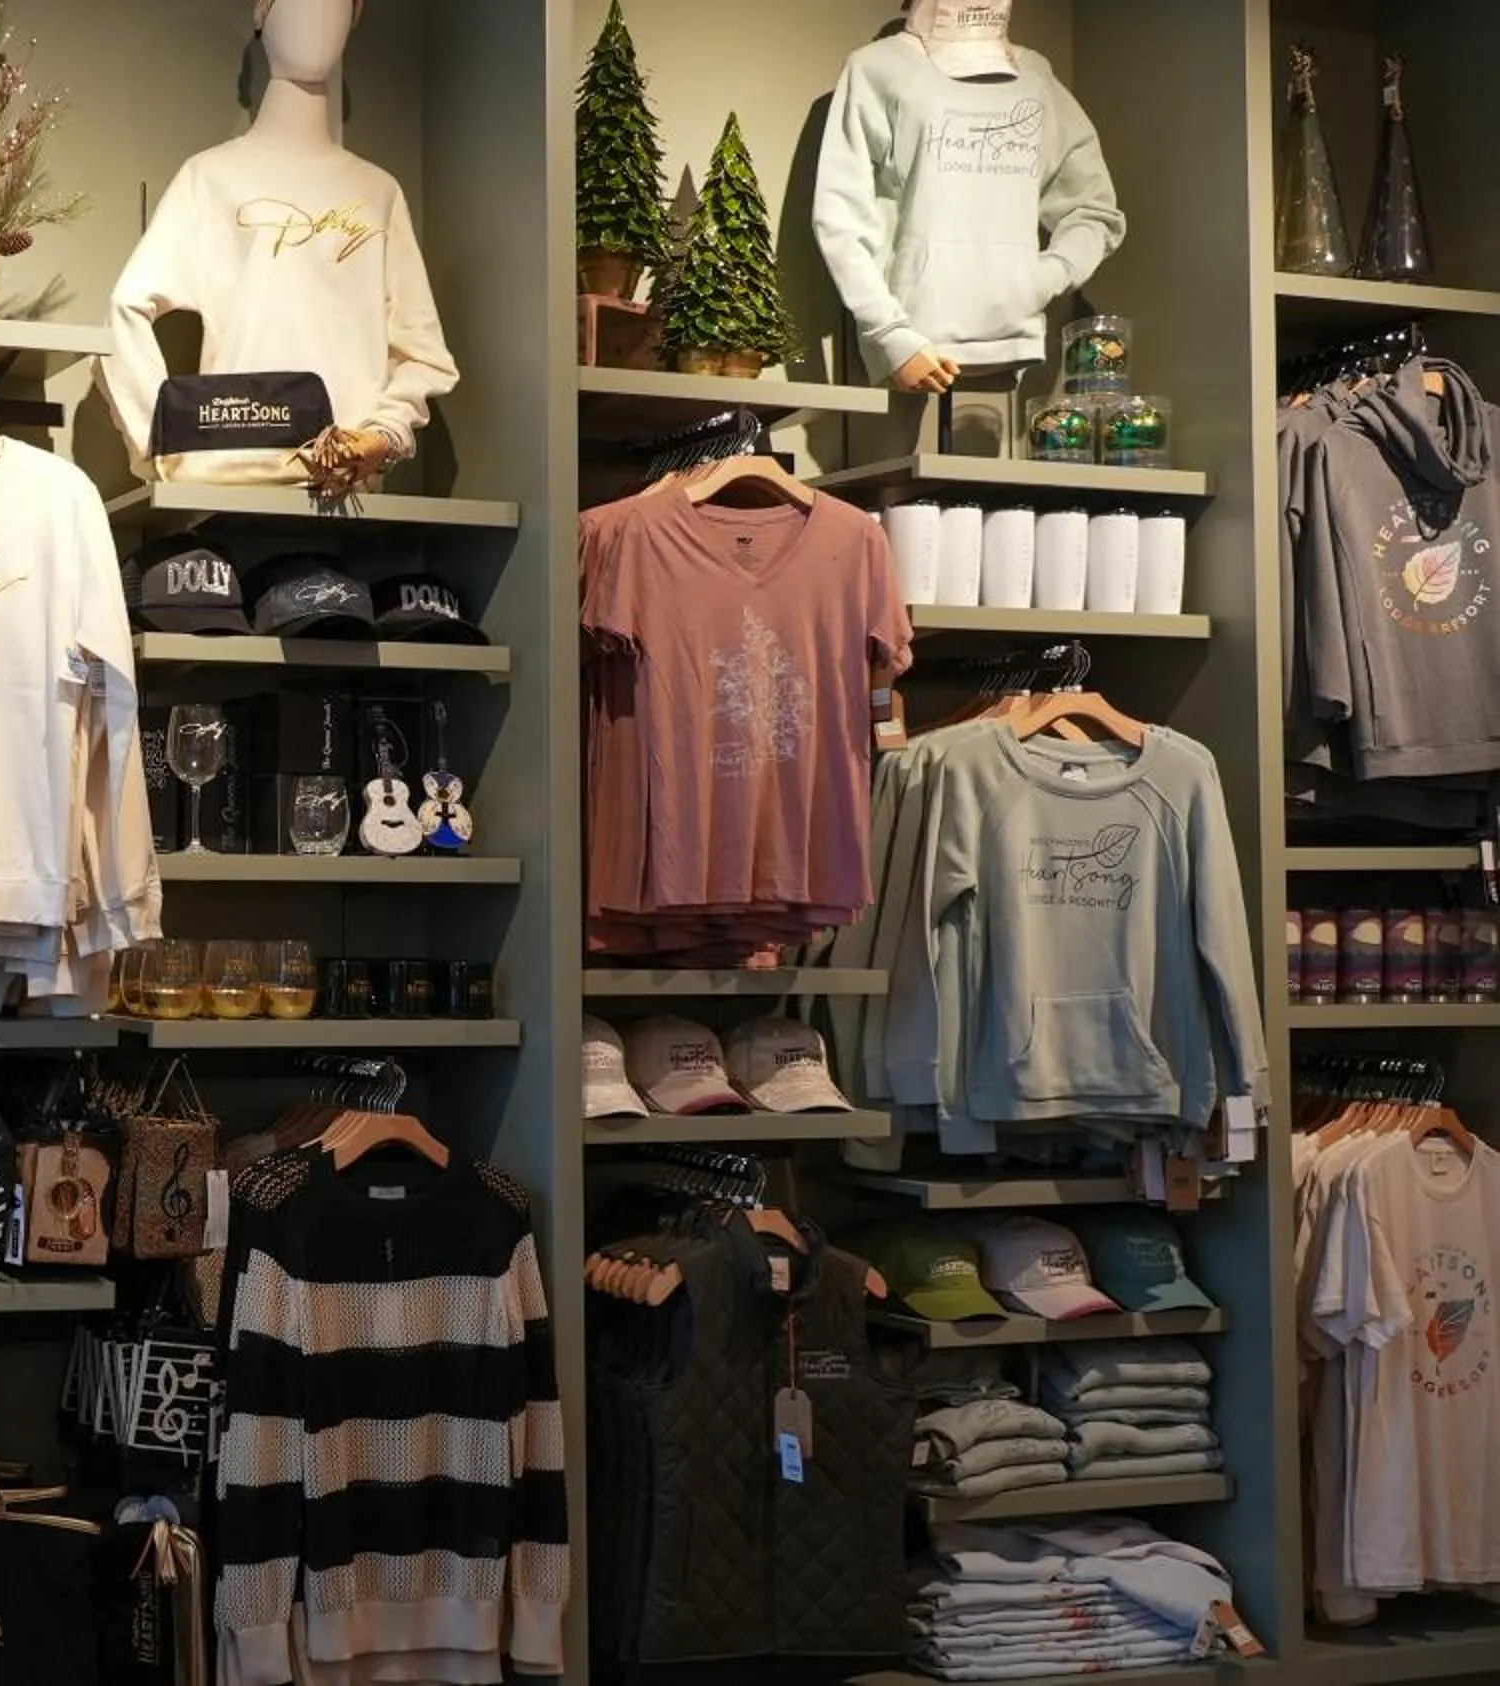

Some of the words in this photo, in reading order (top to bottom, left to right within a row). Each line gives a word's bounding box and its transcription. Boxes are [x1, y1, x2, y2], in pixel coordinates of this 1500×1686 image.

[199, 402, 291, 423] HEARTSONG
[167, 558, 231, 596] DOLLY
[401, 583, 459, 620] DOLLY
